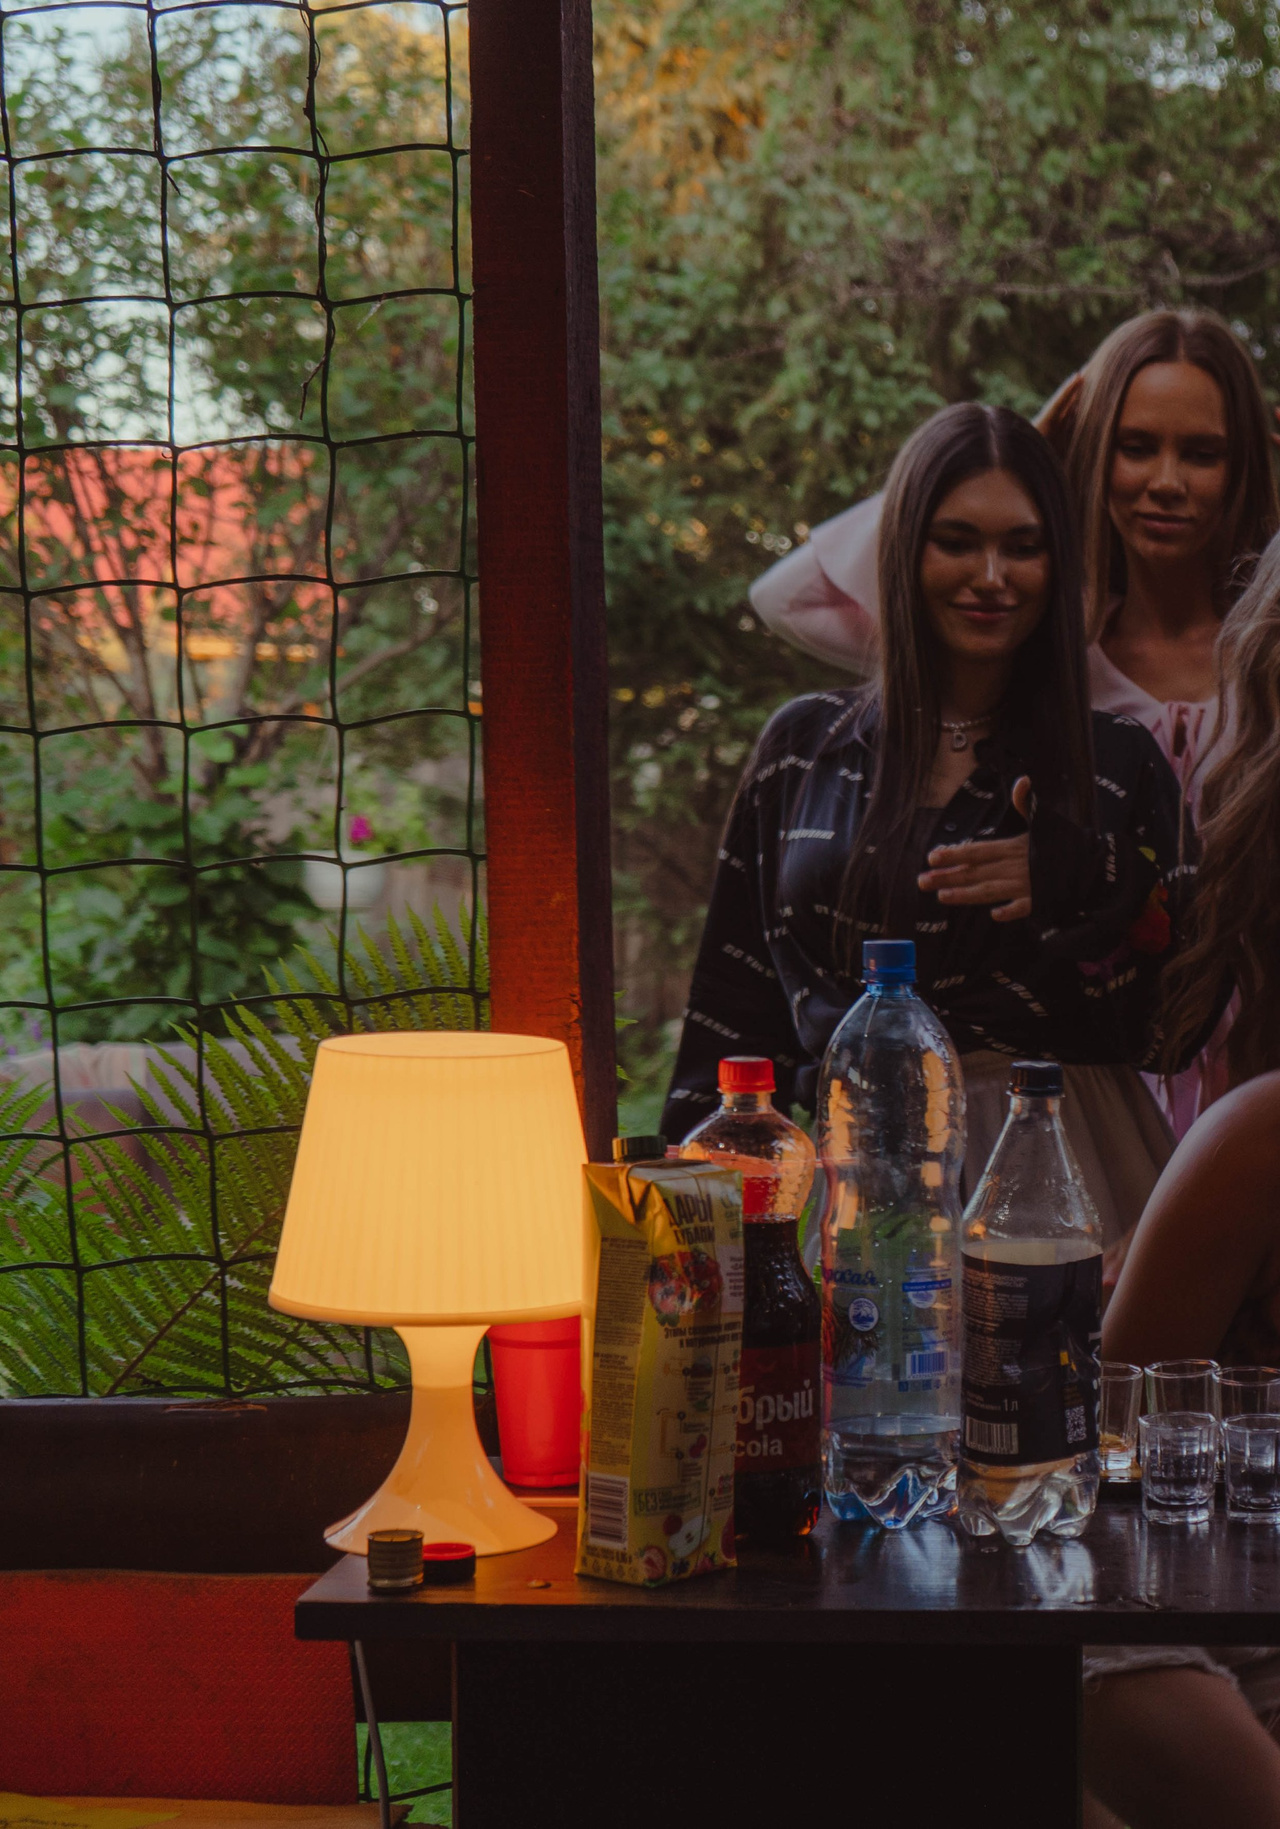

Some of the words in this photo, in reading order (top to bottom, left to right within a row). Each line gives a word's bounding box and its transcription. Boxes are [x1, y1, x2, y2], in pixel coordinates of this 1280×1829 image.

[690, 1011, 741, 1040] WANNA
[1003, 1398, 1009, 1412] 1
[735, 1434, 783, 1457] cola
